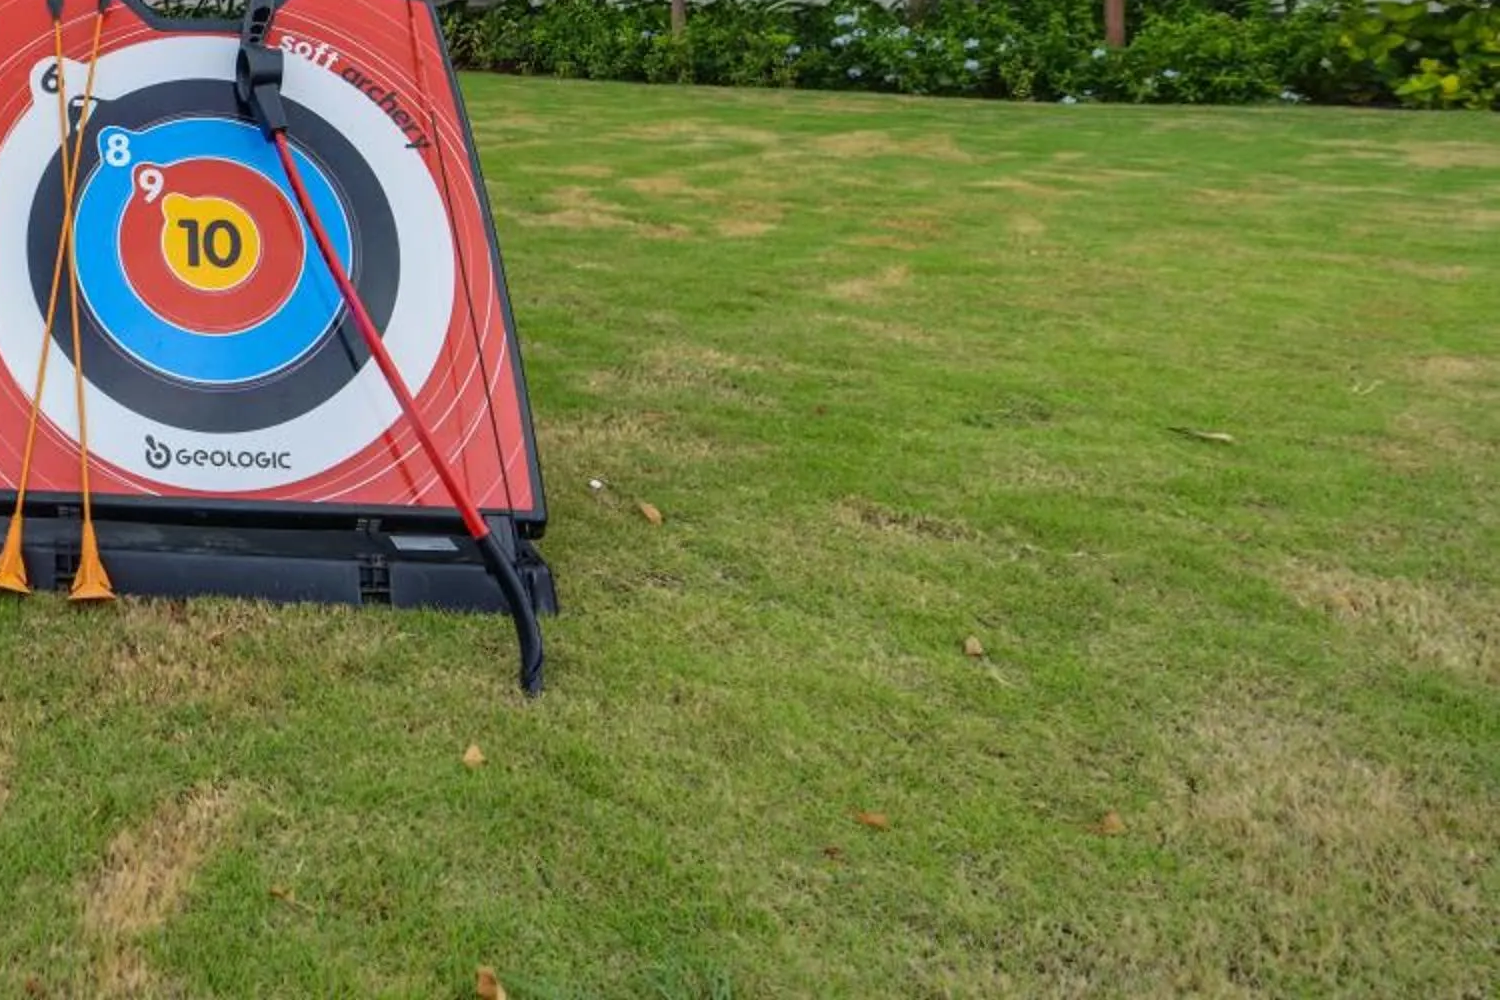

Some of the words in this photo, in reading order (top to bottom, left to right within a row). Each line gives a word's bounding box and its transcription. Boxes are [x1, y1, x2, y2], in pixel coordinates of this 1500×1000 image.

[41, 62, 64, 94] 6
[279, 34, 341, 71] soft
[341, 65, 431, 149] archery
[105, 133, 131, 168] 8
[138, 168, 164, 204] 9
[177, 218, 242, 269] 10
